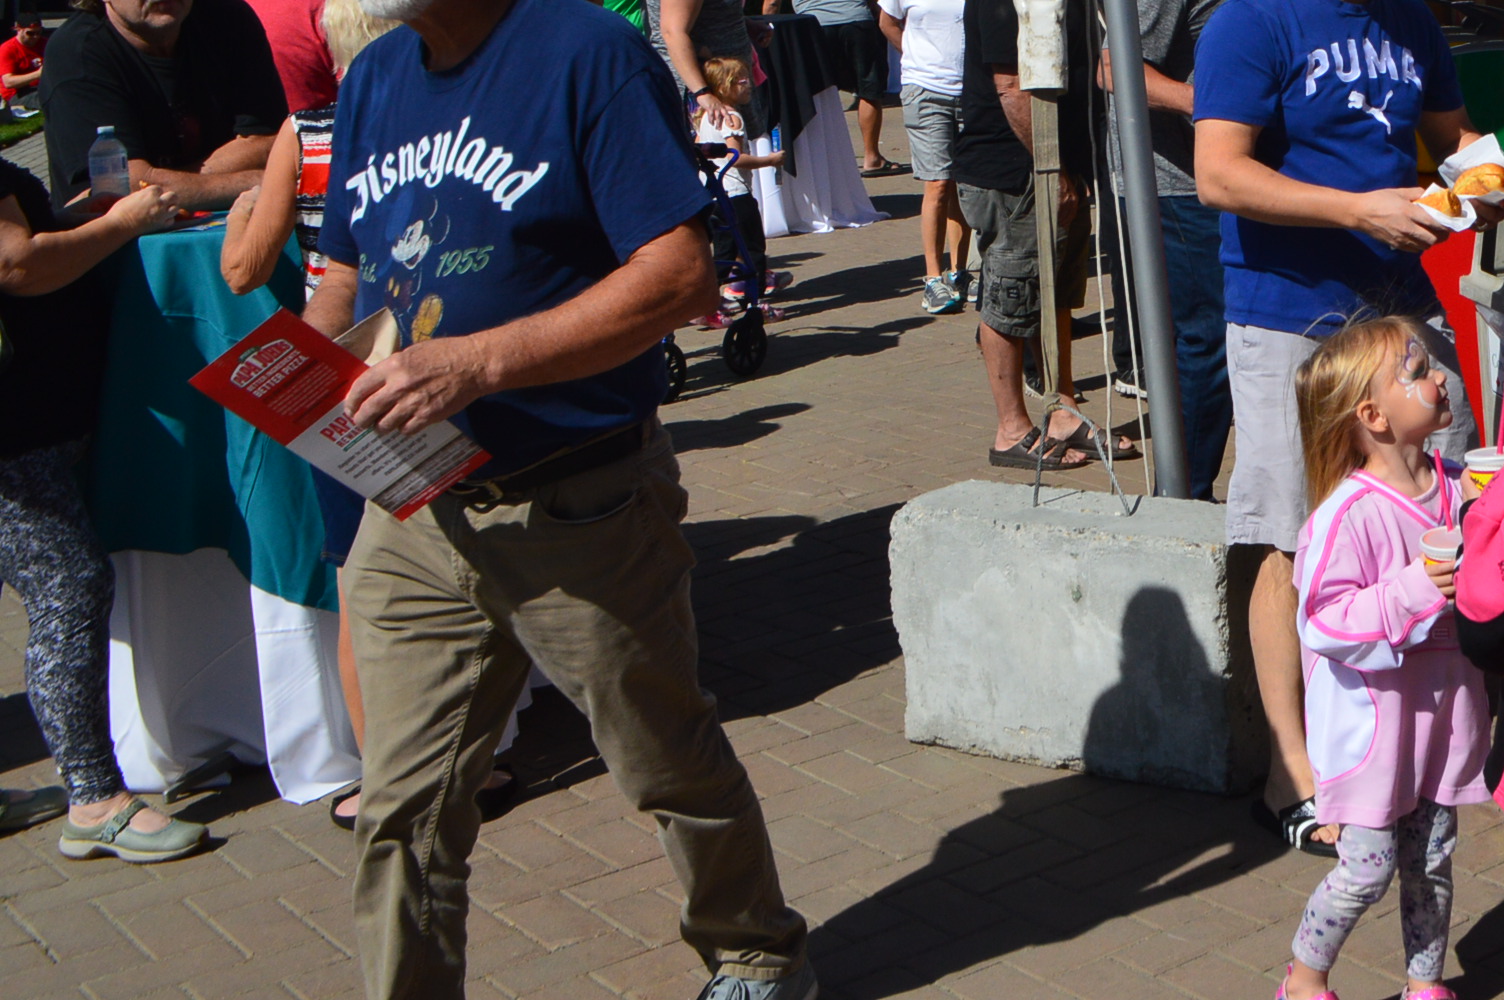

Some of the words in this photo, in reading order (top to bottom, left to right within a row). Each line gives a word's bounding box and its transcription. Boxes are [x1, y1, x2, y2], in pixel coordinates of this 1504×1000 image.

[1305, 37, 1422, 96] PUMA
[346, 115, 549, 229] Disneyland
[436, 245, 495, 278] 1955
[229, 360, 262, 385] PAPA
[246, 374, 268, 391] BETTER
[252, 372, 286, 397] BETTER
